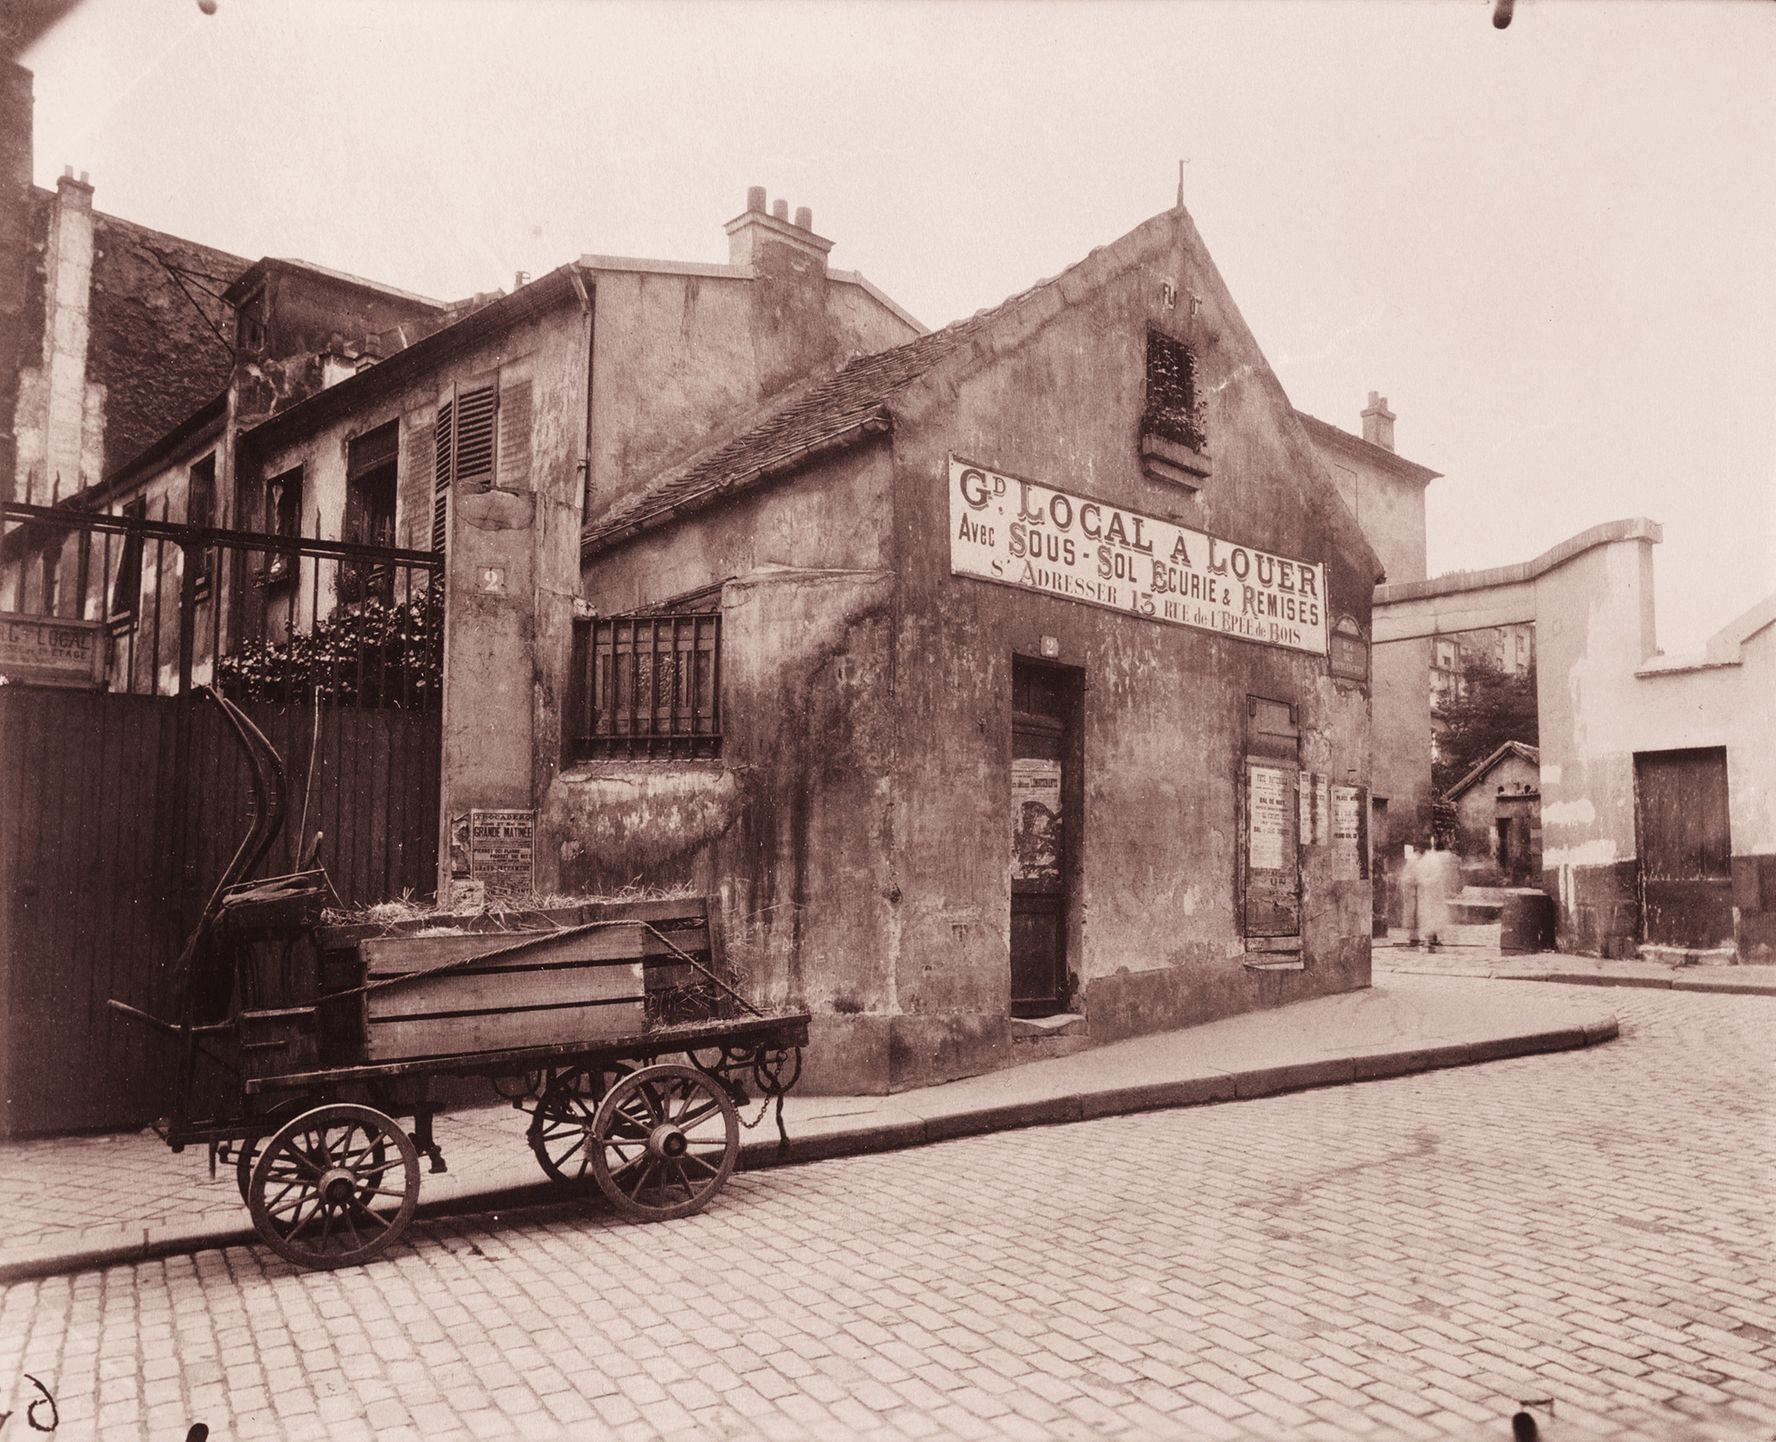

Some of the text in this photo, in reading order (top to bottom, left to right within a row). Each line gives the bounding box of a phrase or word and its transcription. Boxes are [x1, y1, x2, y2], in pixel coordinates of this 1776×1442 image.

[1017, 481, 1153, 557] LOCAL
[1206, 535, 1318, 601] LOUER
[484, 570, 499, 590] 2
[1129, 589, 1157, 617] 13
[1164, 599, 1190, 623] RUE
[1193, 606, 1209, 626] de
[1255, 623, 1267, 638] de
[1269, 622, 1303, 645] BOIS
[1222, 588, 1232, 607] &
[1241, 584, 1319, 627] REMISES
[37, 623, 90, 650] LOCAL
[1044, 639, 1055, 654] 2
